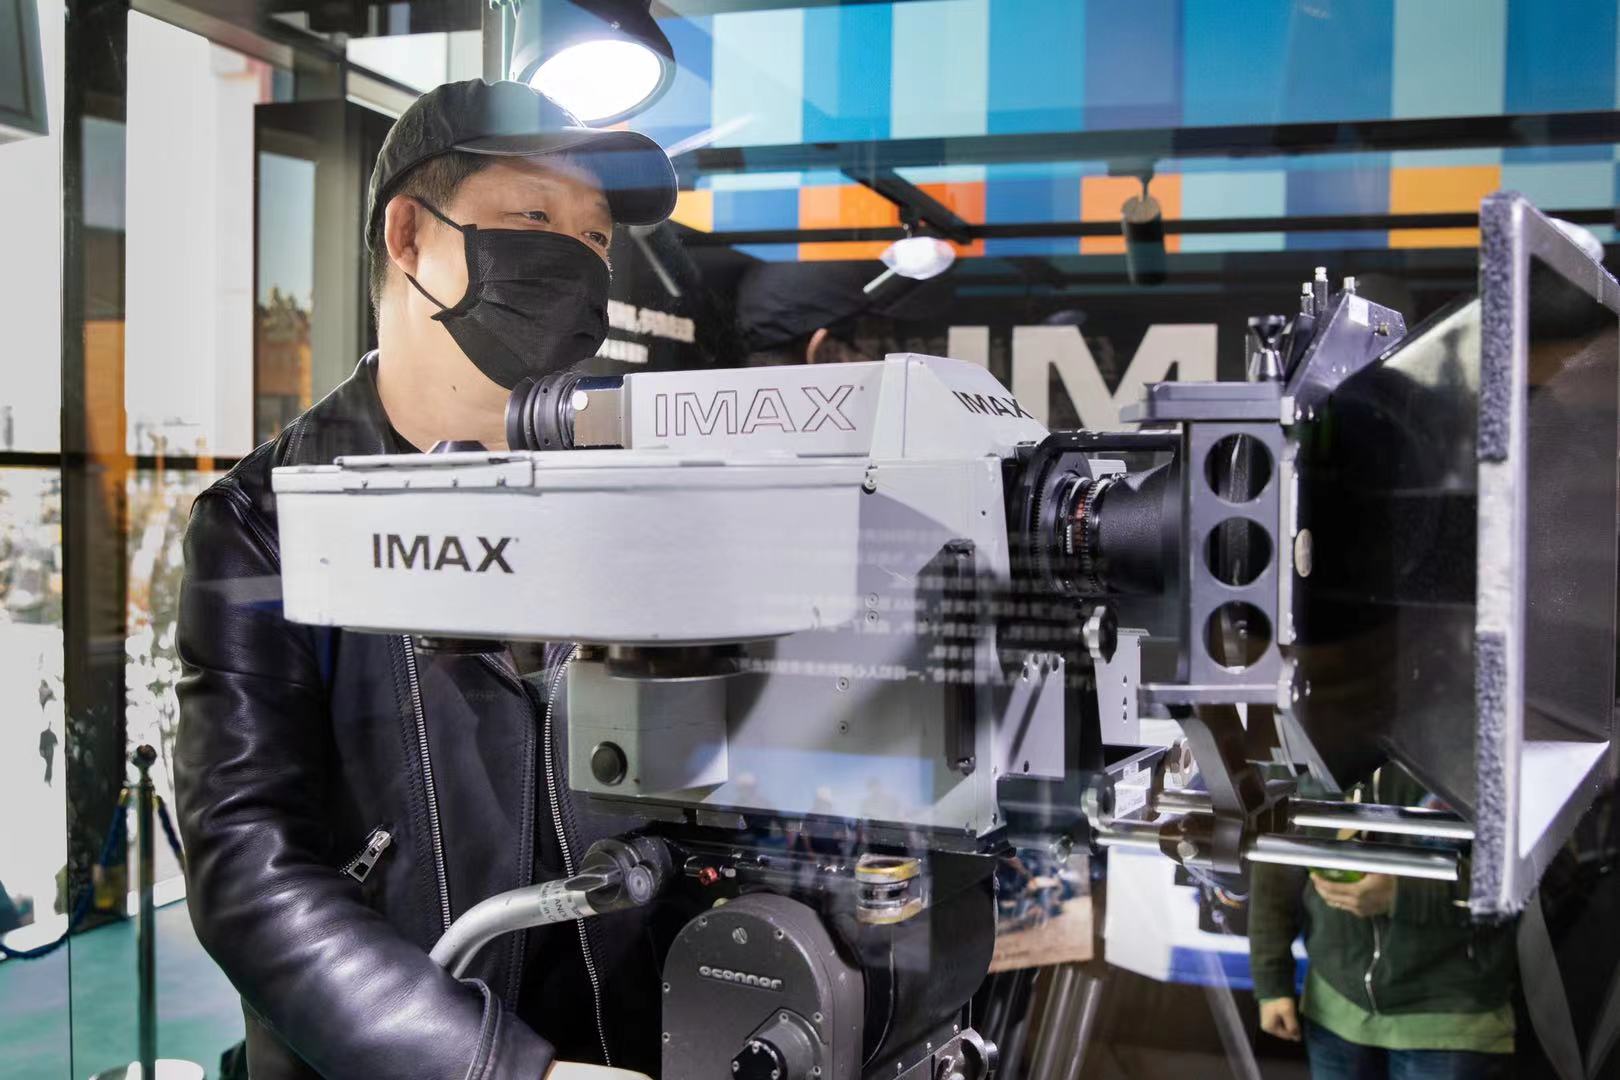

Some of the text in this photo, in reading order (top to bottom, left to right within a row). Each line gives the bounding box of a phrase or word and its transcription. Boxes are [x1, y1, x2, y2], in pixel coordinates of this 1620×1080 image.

[655, 384, 857, 437] IMAX
[952, 390, 1034, 420] IMAX
[373, 533, 515, 574] IMAX
